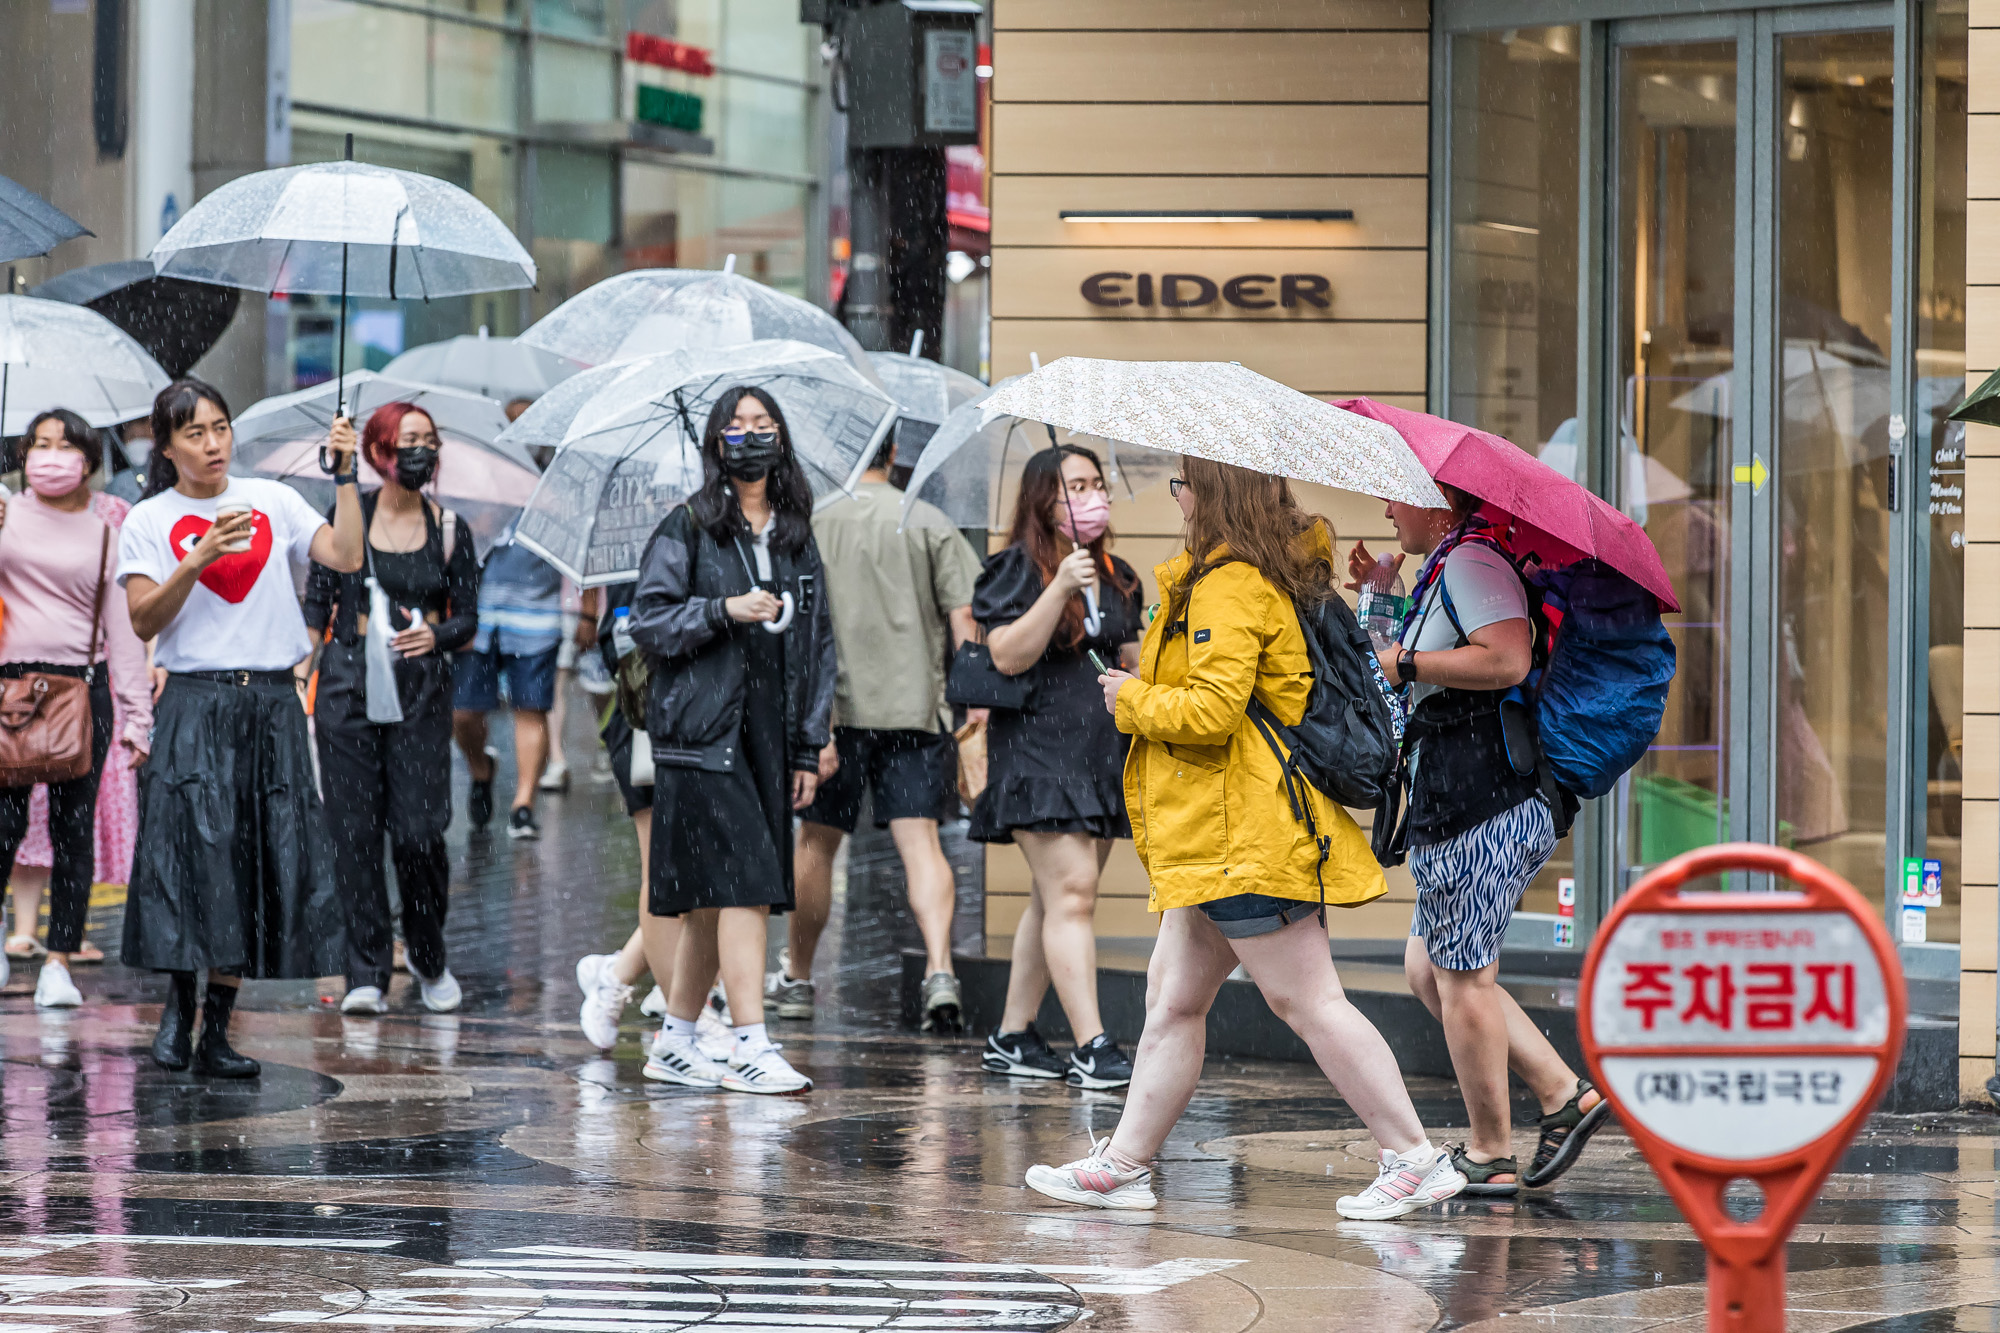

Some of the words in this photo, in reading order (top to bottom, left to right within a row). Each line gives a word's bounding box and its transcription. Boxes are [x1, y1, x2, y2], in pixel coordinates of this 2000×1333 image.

[1080, 271, 1331, 309] EIDER
[1622, 962, 1858, 1032] 주차금지
[1634, 1069, 1843, 1105] (재)국립극단
